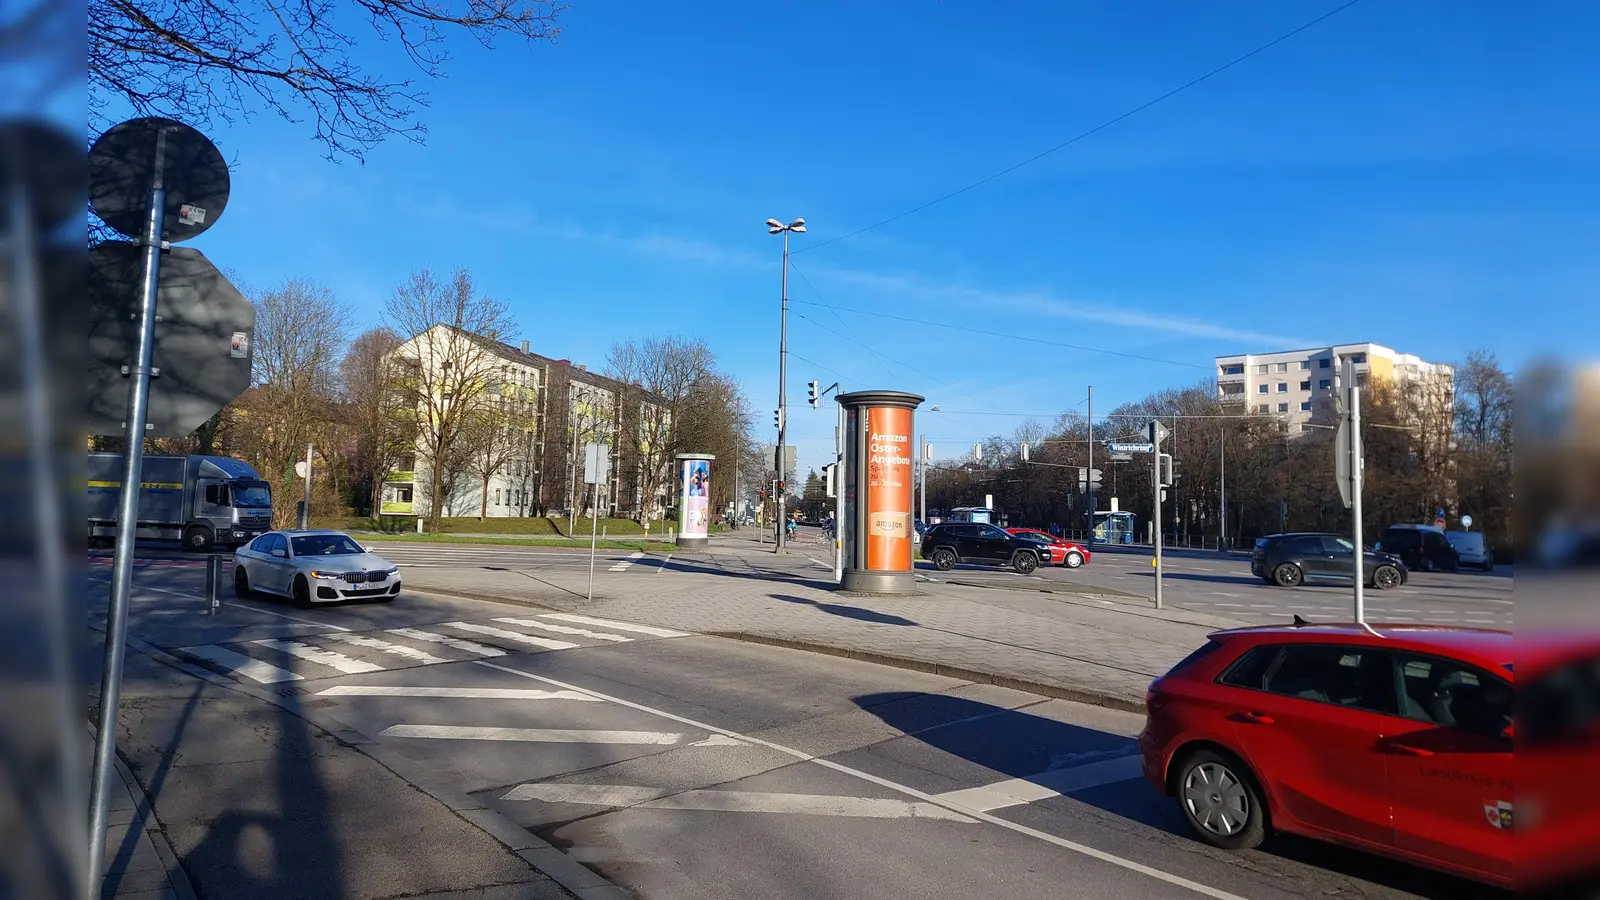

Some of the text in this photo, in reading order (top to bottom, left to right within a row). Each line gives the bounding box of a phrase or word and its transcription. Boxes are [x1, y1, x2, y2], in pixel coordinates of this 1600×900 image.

[871, 432, 908, 443] Amazon
[871, 443, 902, 453] Oster-
[876, 520, 903, 529] amazon
[1420, 762, 1493, 785] Landkreis
